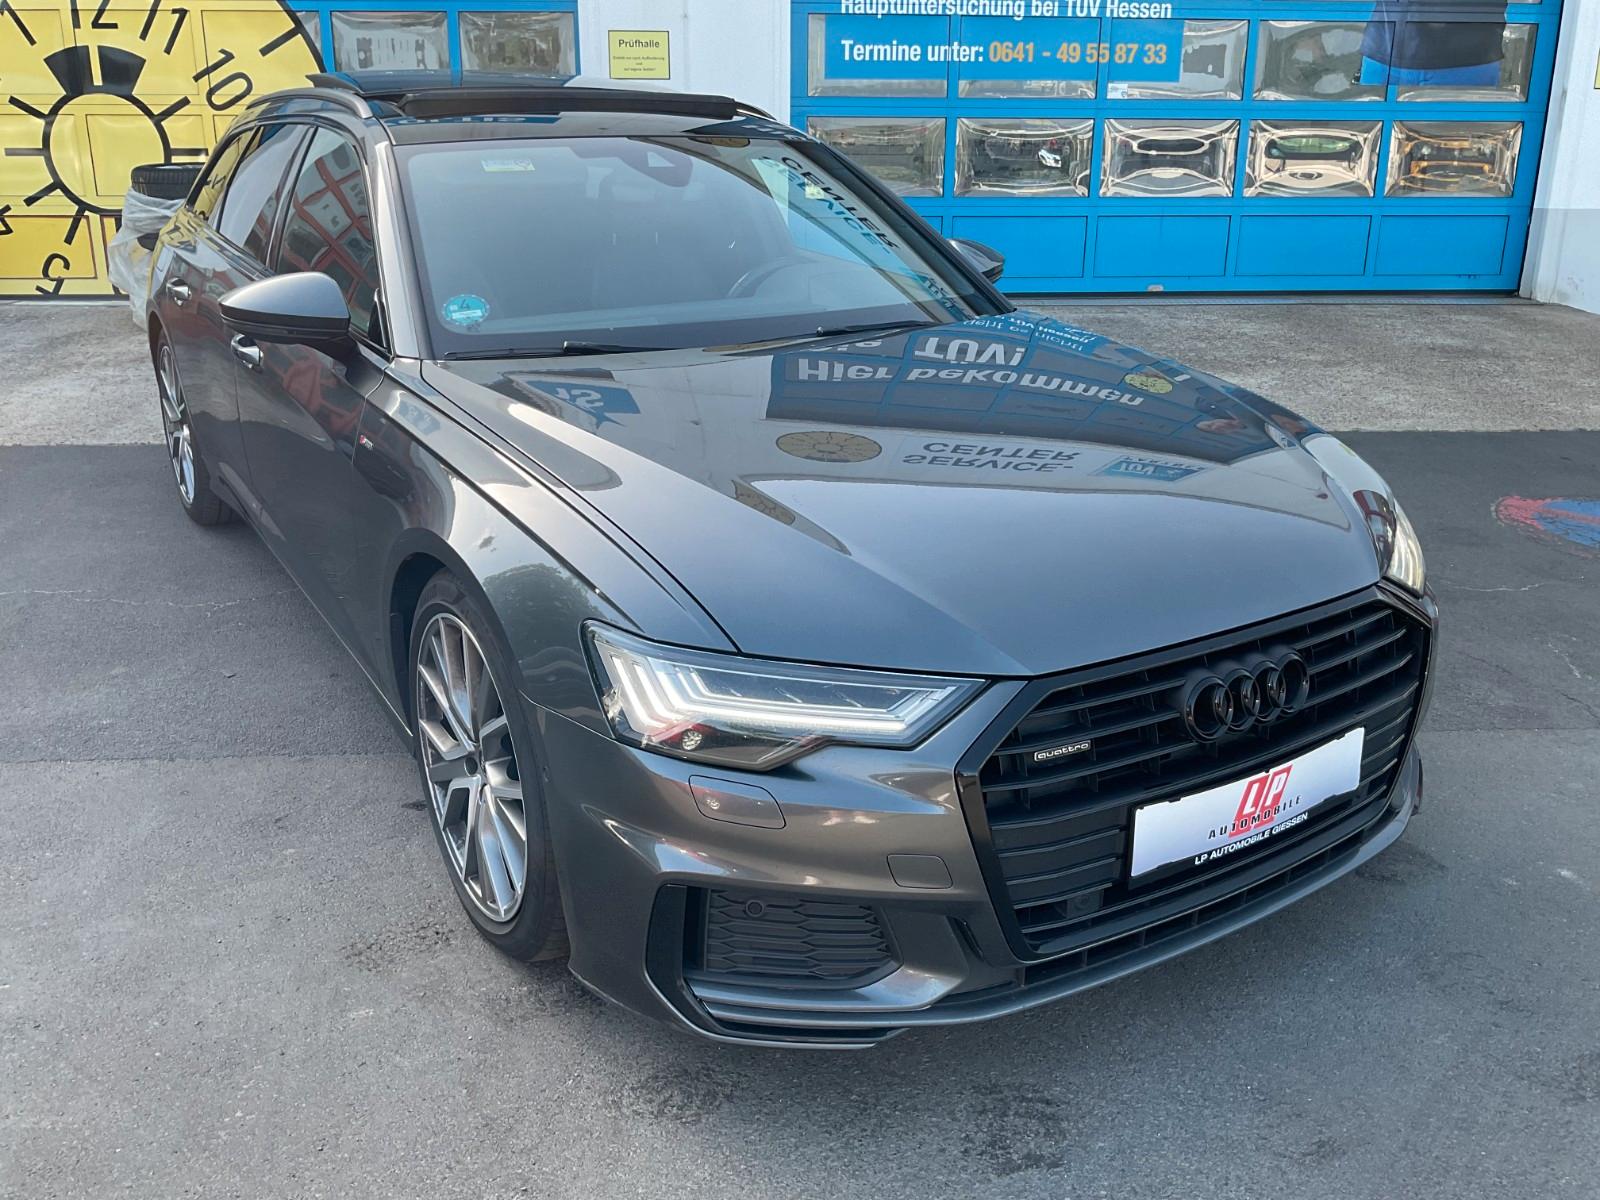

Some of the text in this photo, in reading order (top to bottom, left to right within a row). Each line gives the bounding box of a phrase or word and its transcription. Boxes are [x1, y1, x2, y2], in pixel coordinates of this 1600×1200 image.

[840, 0, 1025, 20] Hauptuntersuchung
[1030, 0, 1059, 17] bei
[1105, 0, 1173, 19] Hessen
[618, 38, 660, 48] Prüfhalle
[840, 39, 922, 61] Termine
[926, 41, 985, 62] unter:
[988, 41, 1035, 63] 0641
[1056, 42, 1082, 63] 49
[1085, 43, 1111, 64] 55
[1114, 44, 1139, 64] 87
[1143, 44, 1168, 64] 33
[191, 48, 254, 112] 10
[1037, 743, 1089, 760] quattro
[1207, 795, 1302, 840] AUTOMOBILE
[1194, 812, 1309, 865] LP AUTOMOBILE GIESSEN
